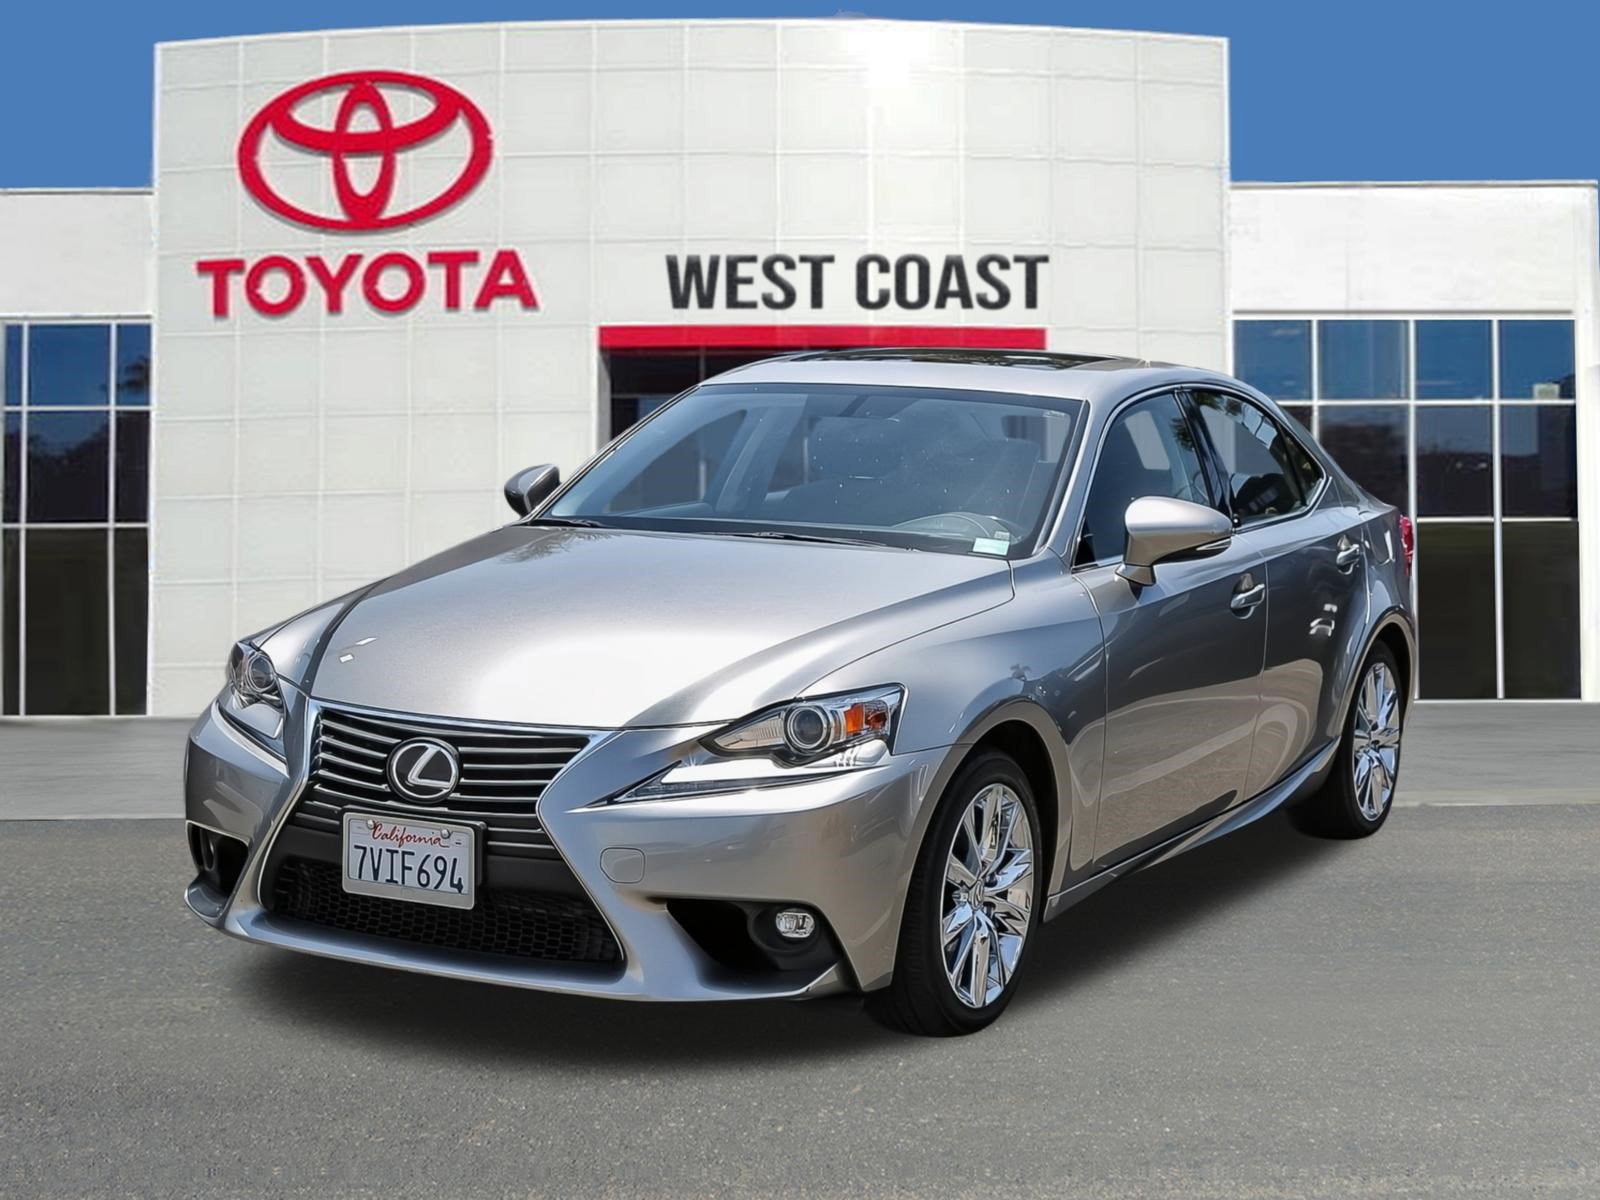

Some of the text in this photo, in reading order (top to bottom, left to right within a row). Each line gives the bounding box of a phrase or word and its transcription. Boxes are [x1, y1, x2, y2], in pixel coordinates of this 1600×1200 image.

[197, 249, 538, 318] TOYOTA
[666, 253, 1049, 311] WEST COAST
[371, 820, 449, 848] California
[353, 844, 464, 894] 7VIF694
